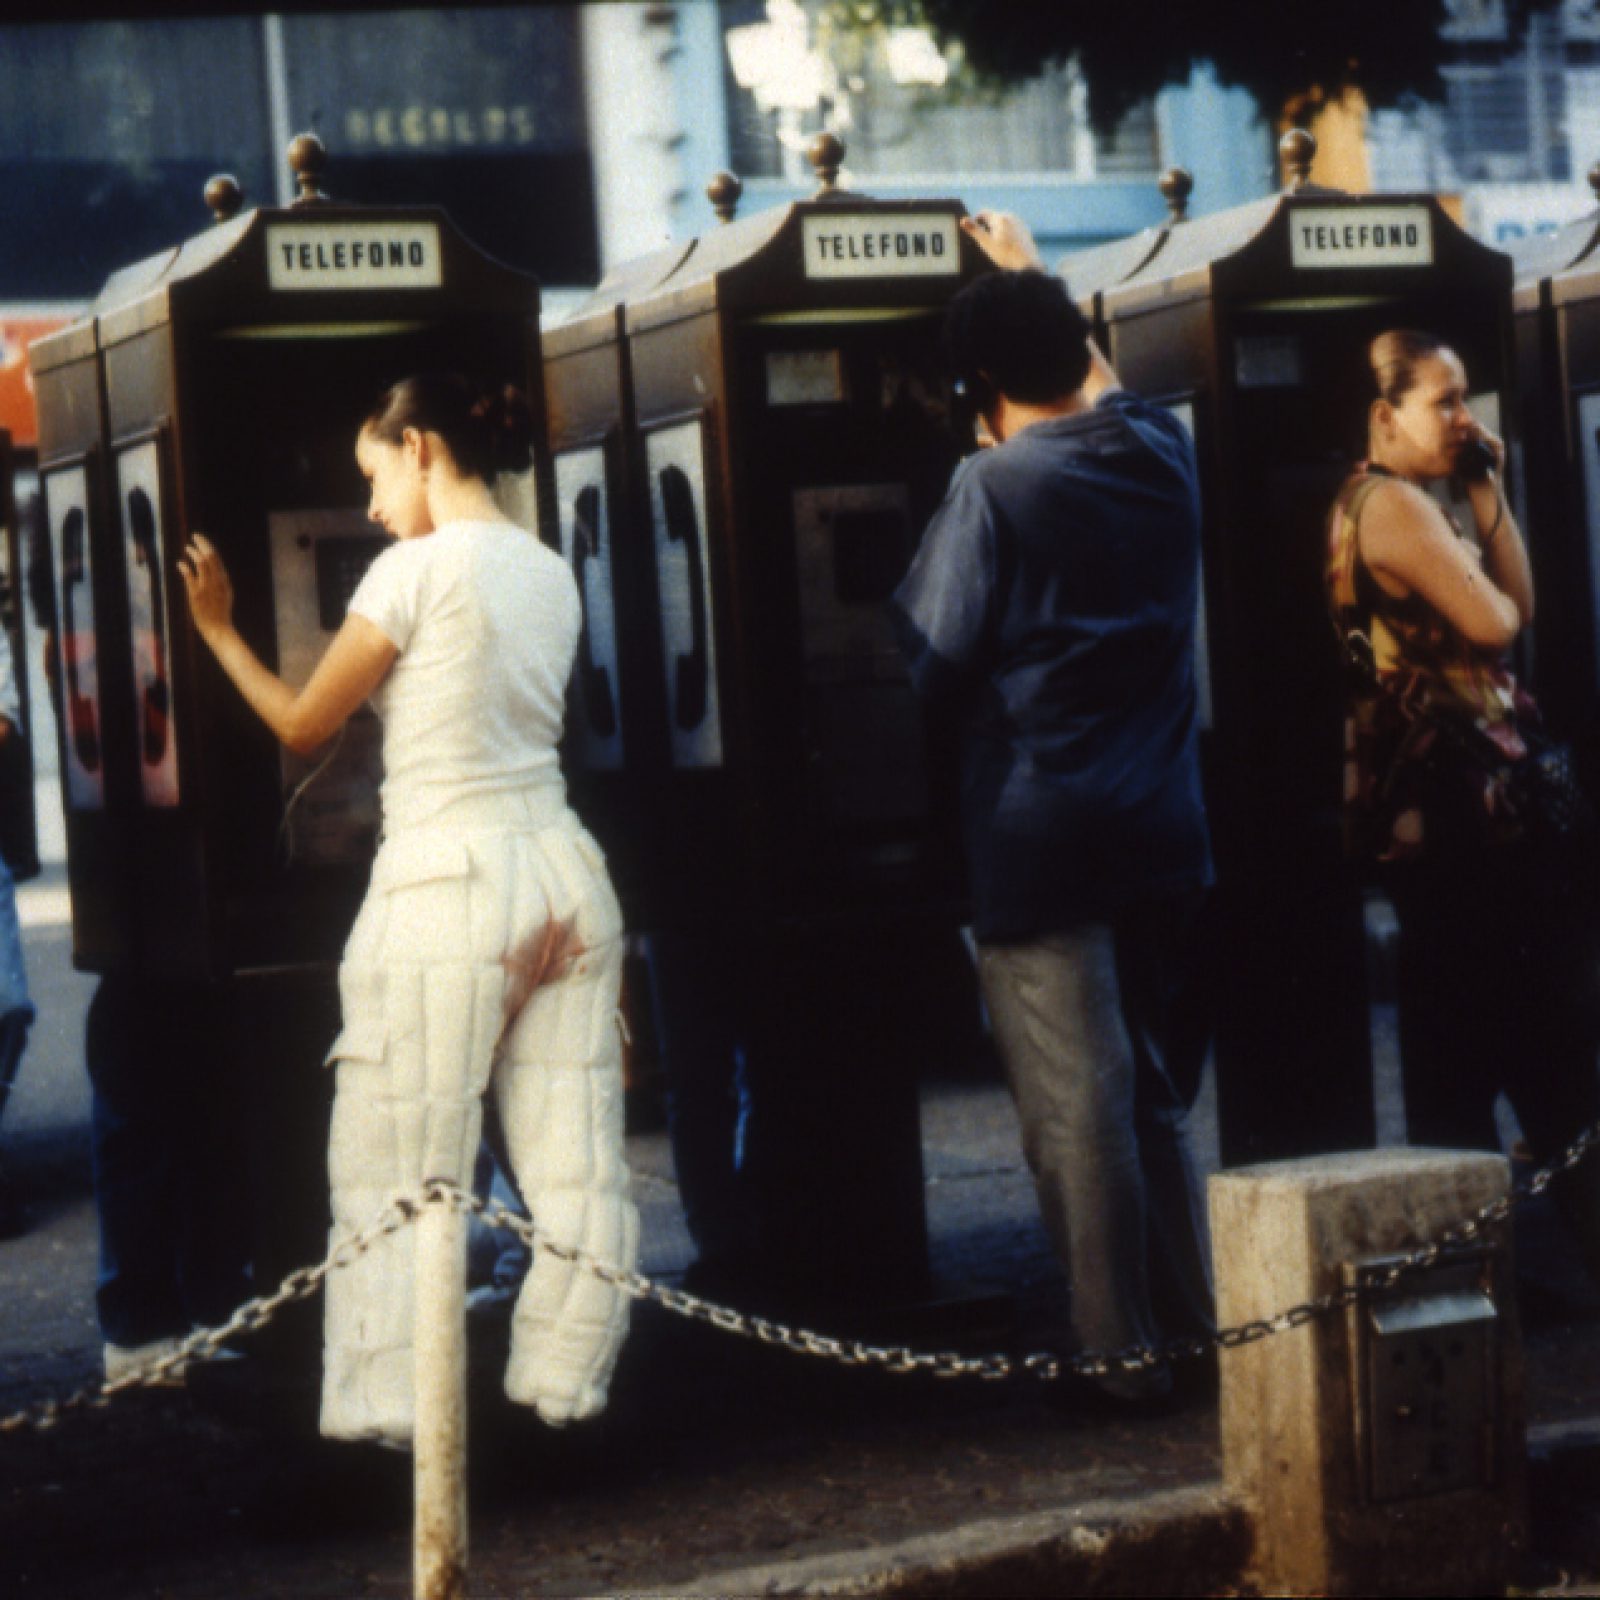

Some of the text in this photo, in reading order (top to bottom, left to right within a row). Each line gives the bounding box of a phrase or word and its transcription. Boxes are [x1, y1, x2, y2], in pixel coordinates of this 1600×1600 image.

[816, 231, 944, 260] TELEFONO
[1302, 223, 1418, 250] TELEFONO
[281, 240, 425, 271] TELEFONO
